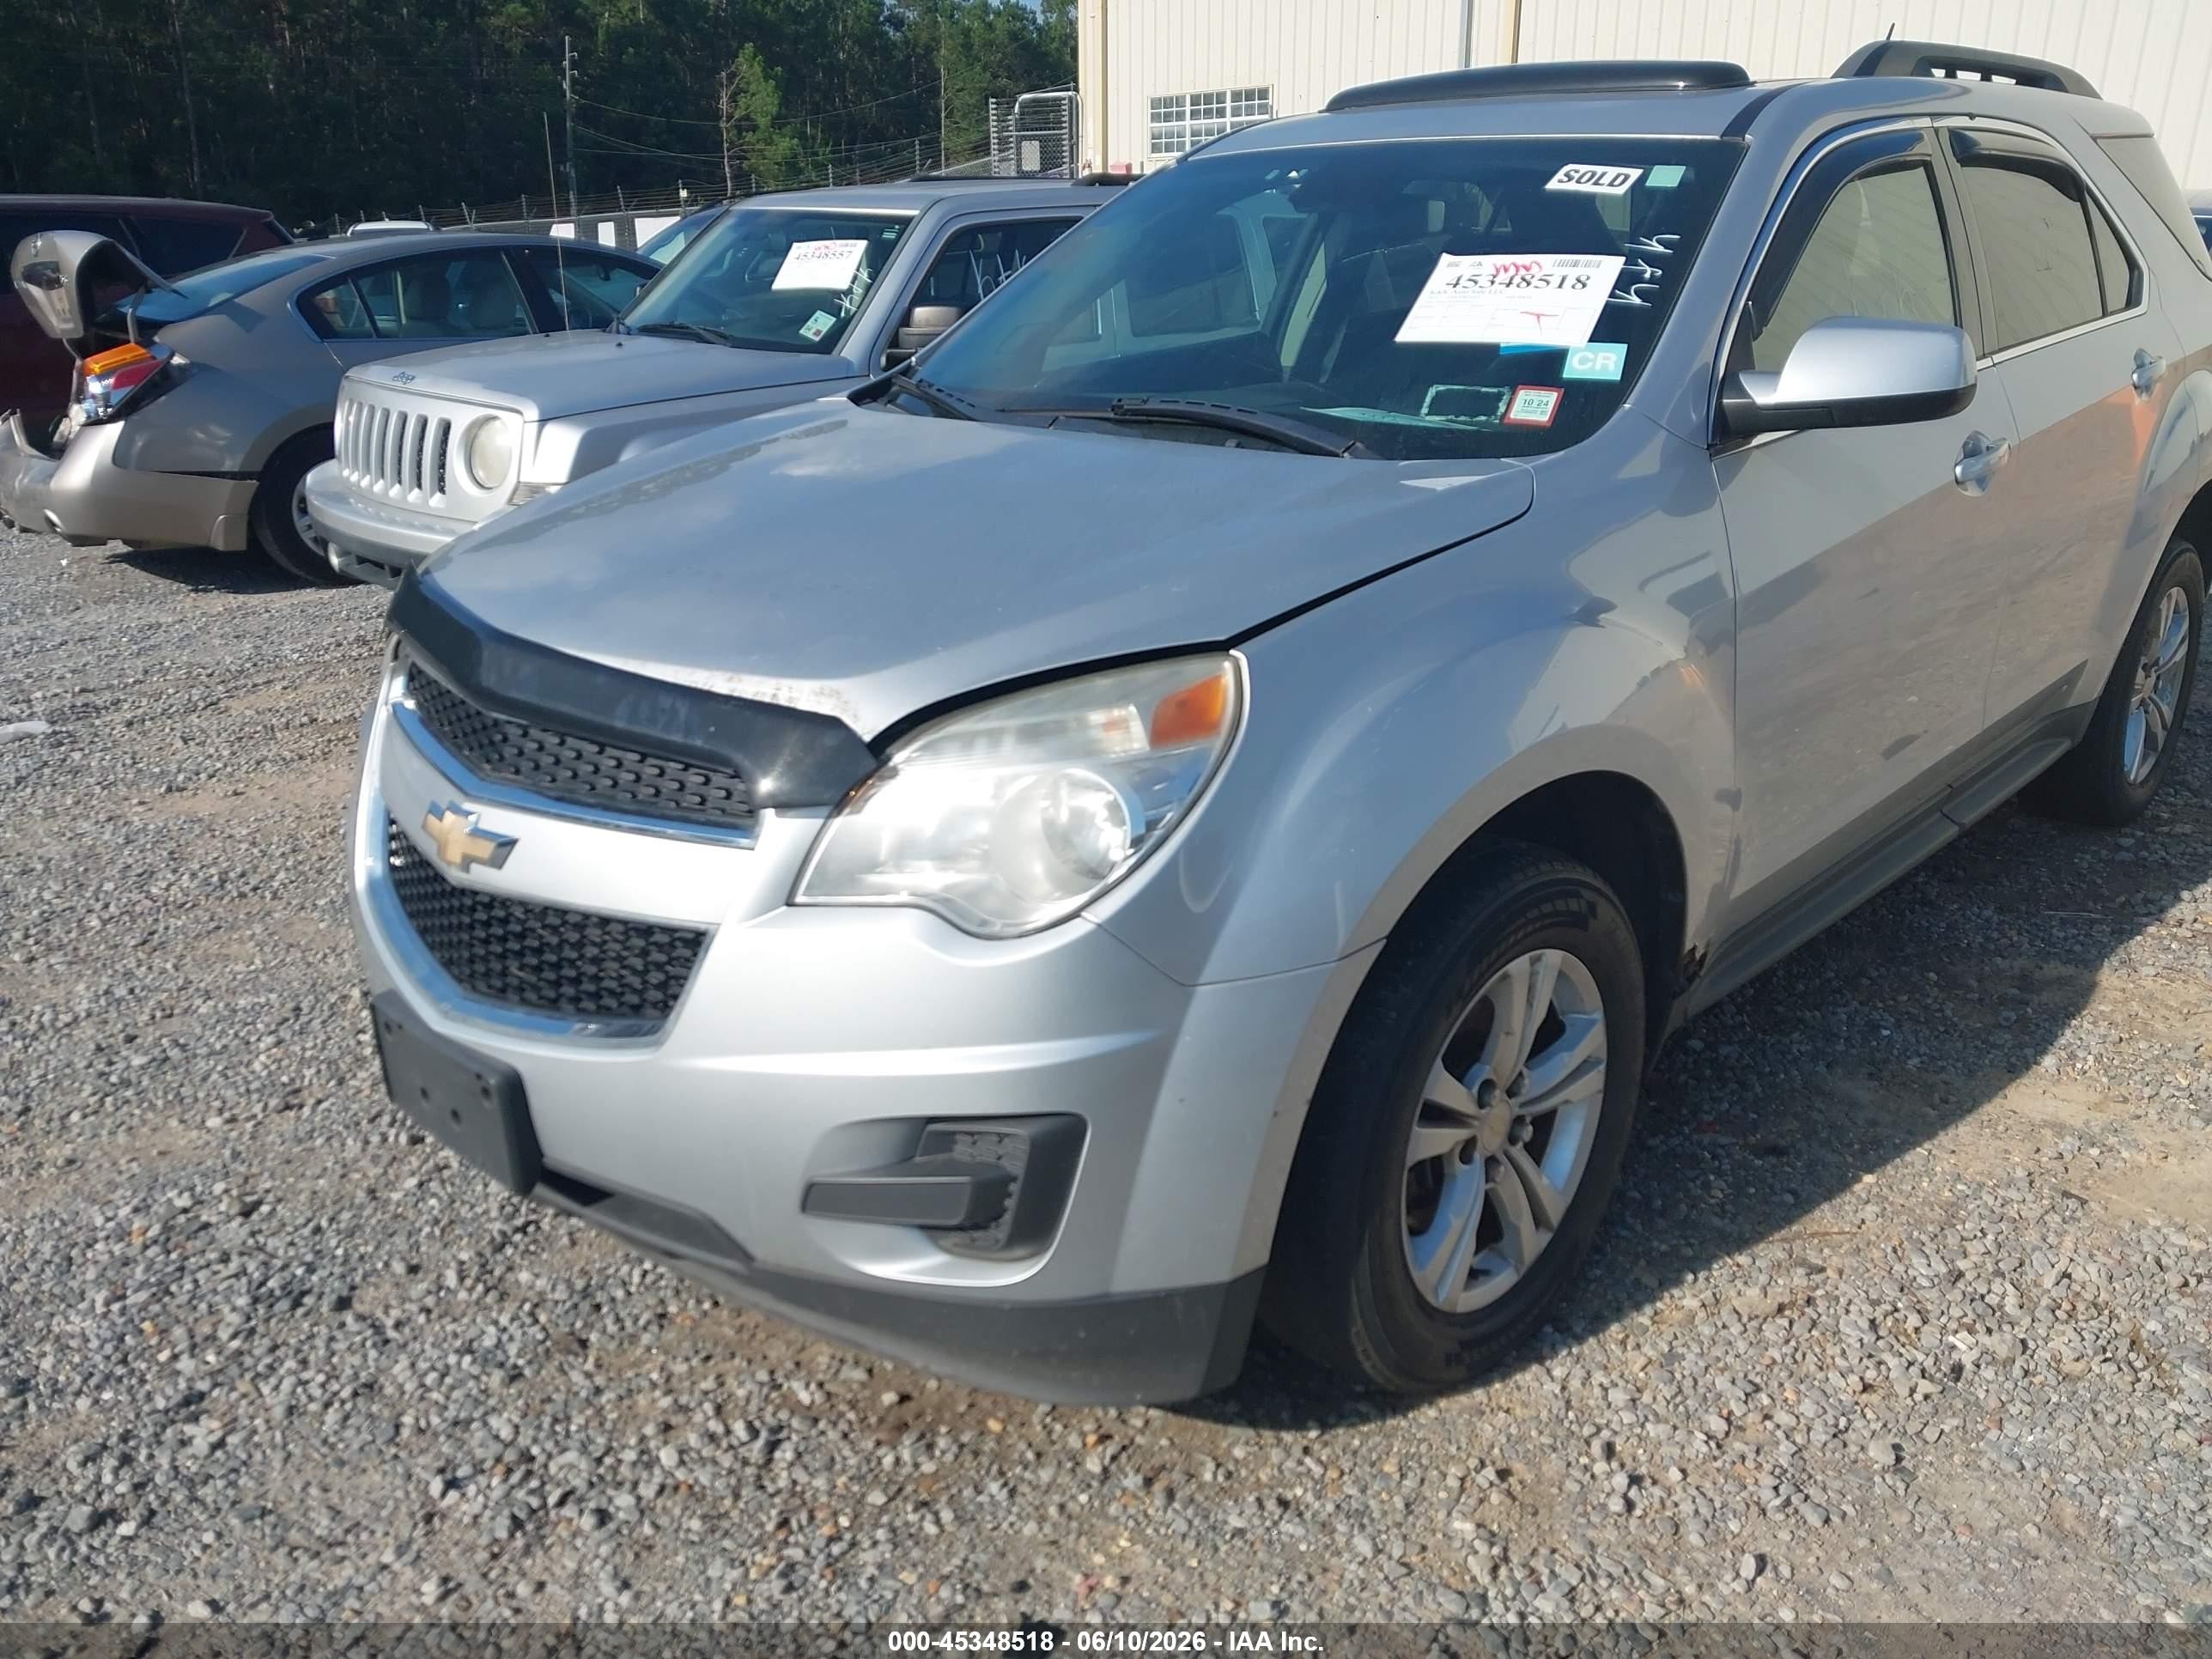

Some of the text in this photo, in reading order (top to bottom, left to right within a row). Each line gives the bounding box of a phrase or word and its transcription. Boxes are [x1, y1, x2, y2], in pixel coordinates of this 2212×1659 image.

[1557, 168, 1632, 187] SOLD
[1445, 274, 1591, 290] 45348518
[1572, 351, 1619, 370] CR
